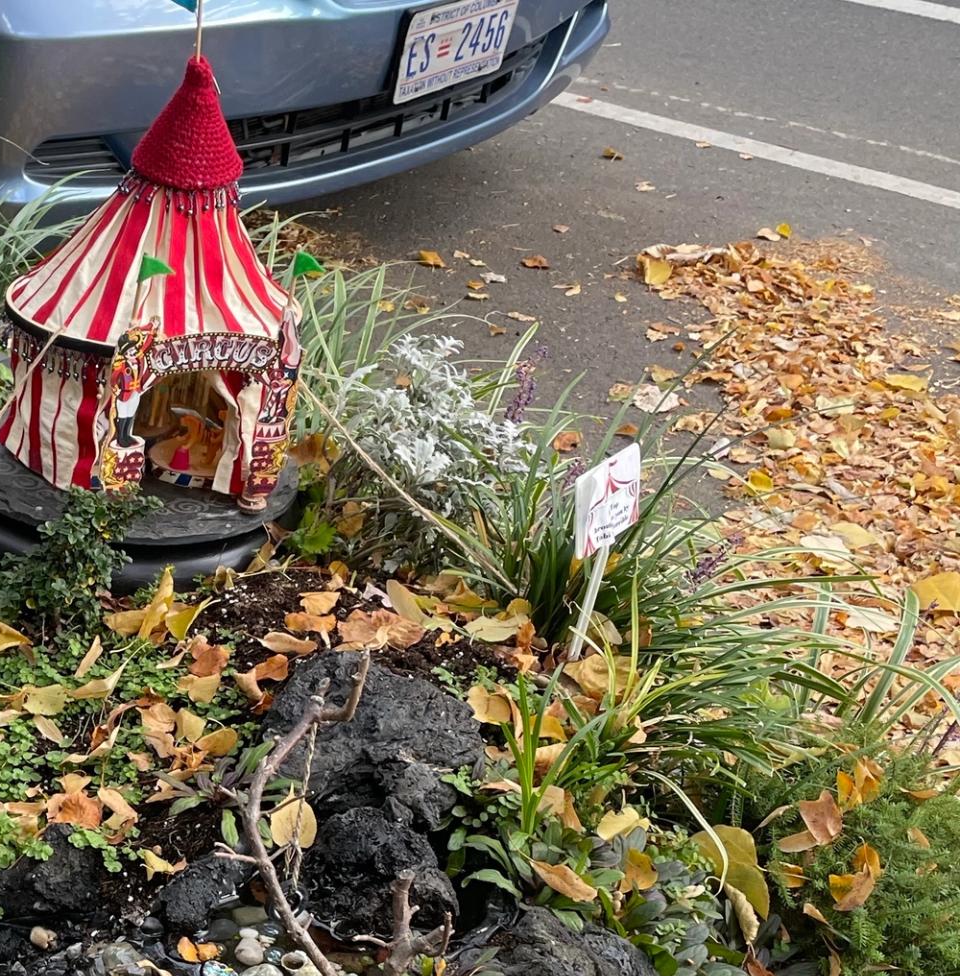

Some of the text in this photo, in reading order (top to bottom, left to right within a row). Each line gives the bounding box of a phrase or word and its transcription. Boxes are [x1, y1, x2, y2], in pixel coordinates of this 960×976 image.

[406, 10, 509, 78] ES 2456
[154, 338, 273, 370] CIRCUS
